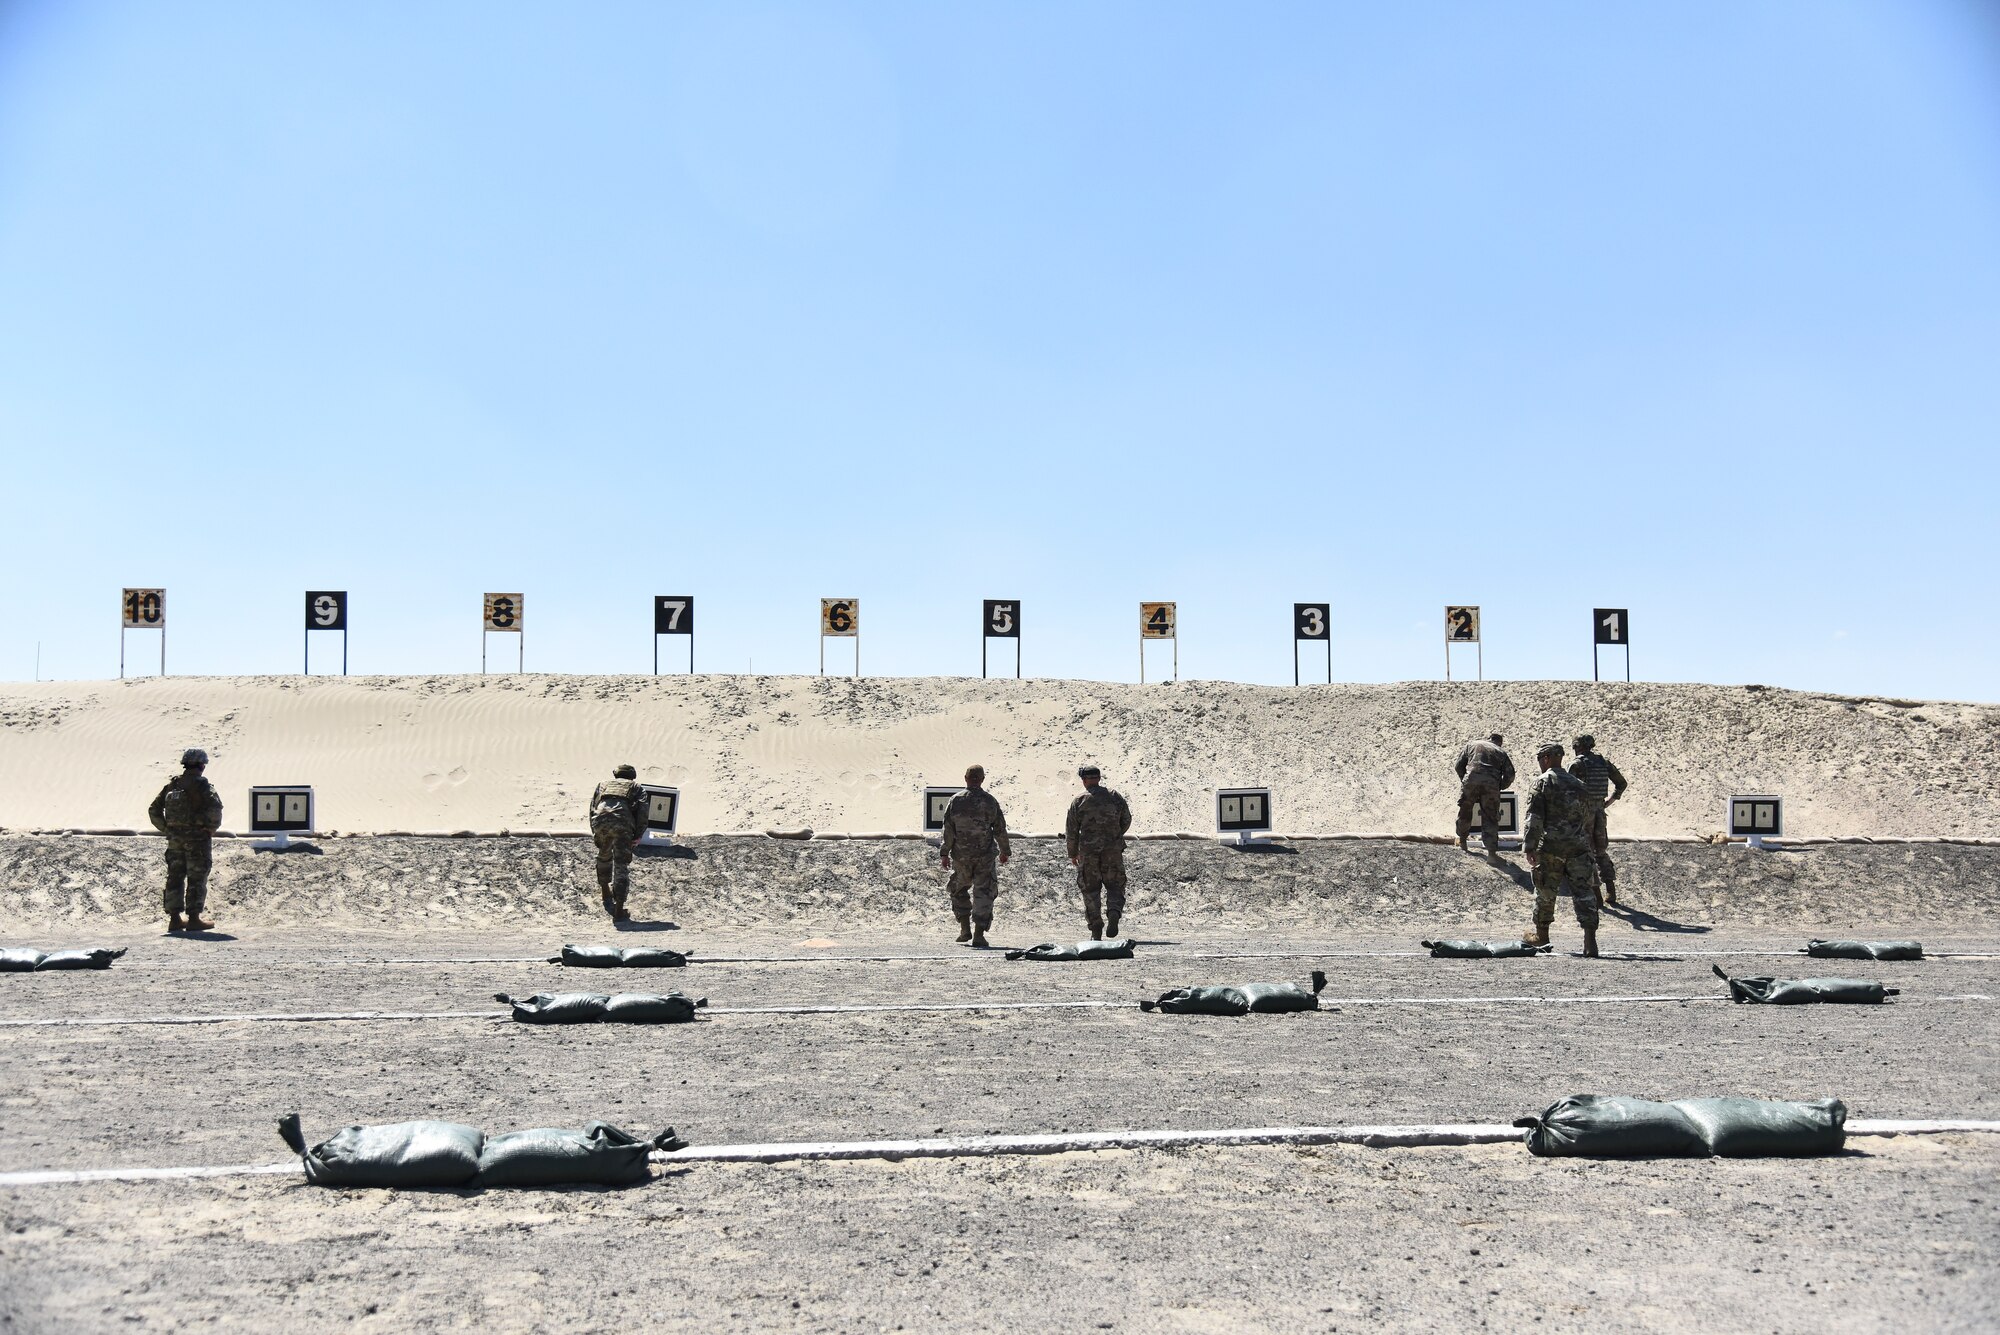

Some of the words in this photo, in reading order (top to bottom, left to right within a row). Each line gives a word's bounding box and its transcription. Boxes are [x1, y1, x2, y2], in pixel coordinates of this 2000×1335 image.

[128, 593, 160, 623] 10
[314, 596, 338, 625] 9
[493, 597, 515, 628] 8
[664, 601, 687, 629] 7
[829, 603, 851, 632] 6
[992, 604, 1012, 633] 5
[1147, 607, 1169, 635] 4
[1301, 608, 1324, 636] 3
[1453, 609, 1473, 637] 2
[1602, 613, 1619, 640] 1
